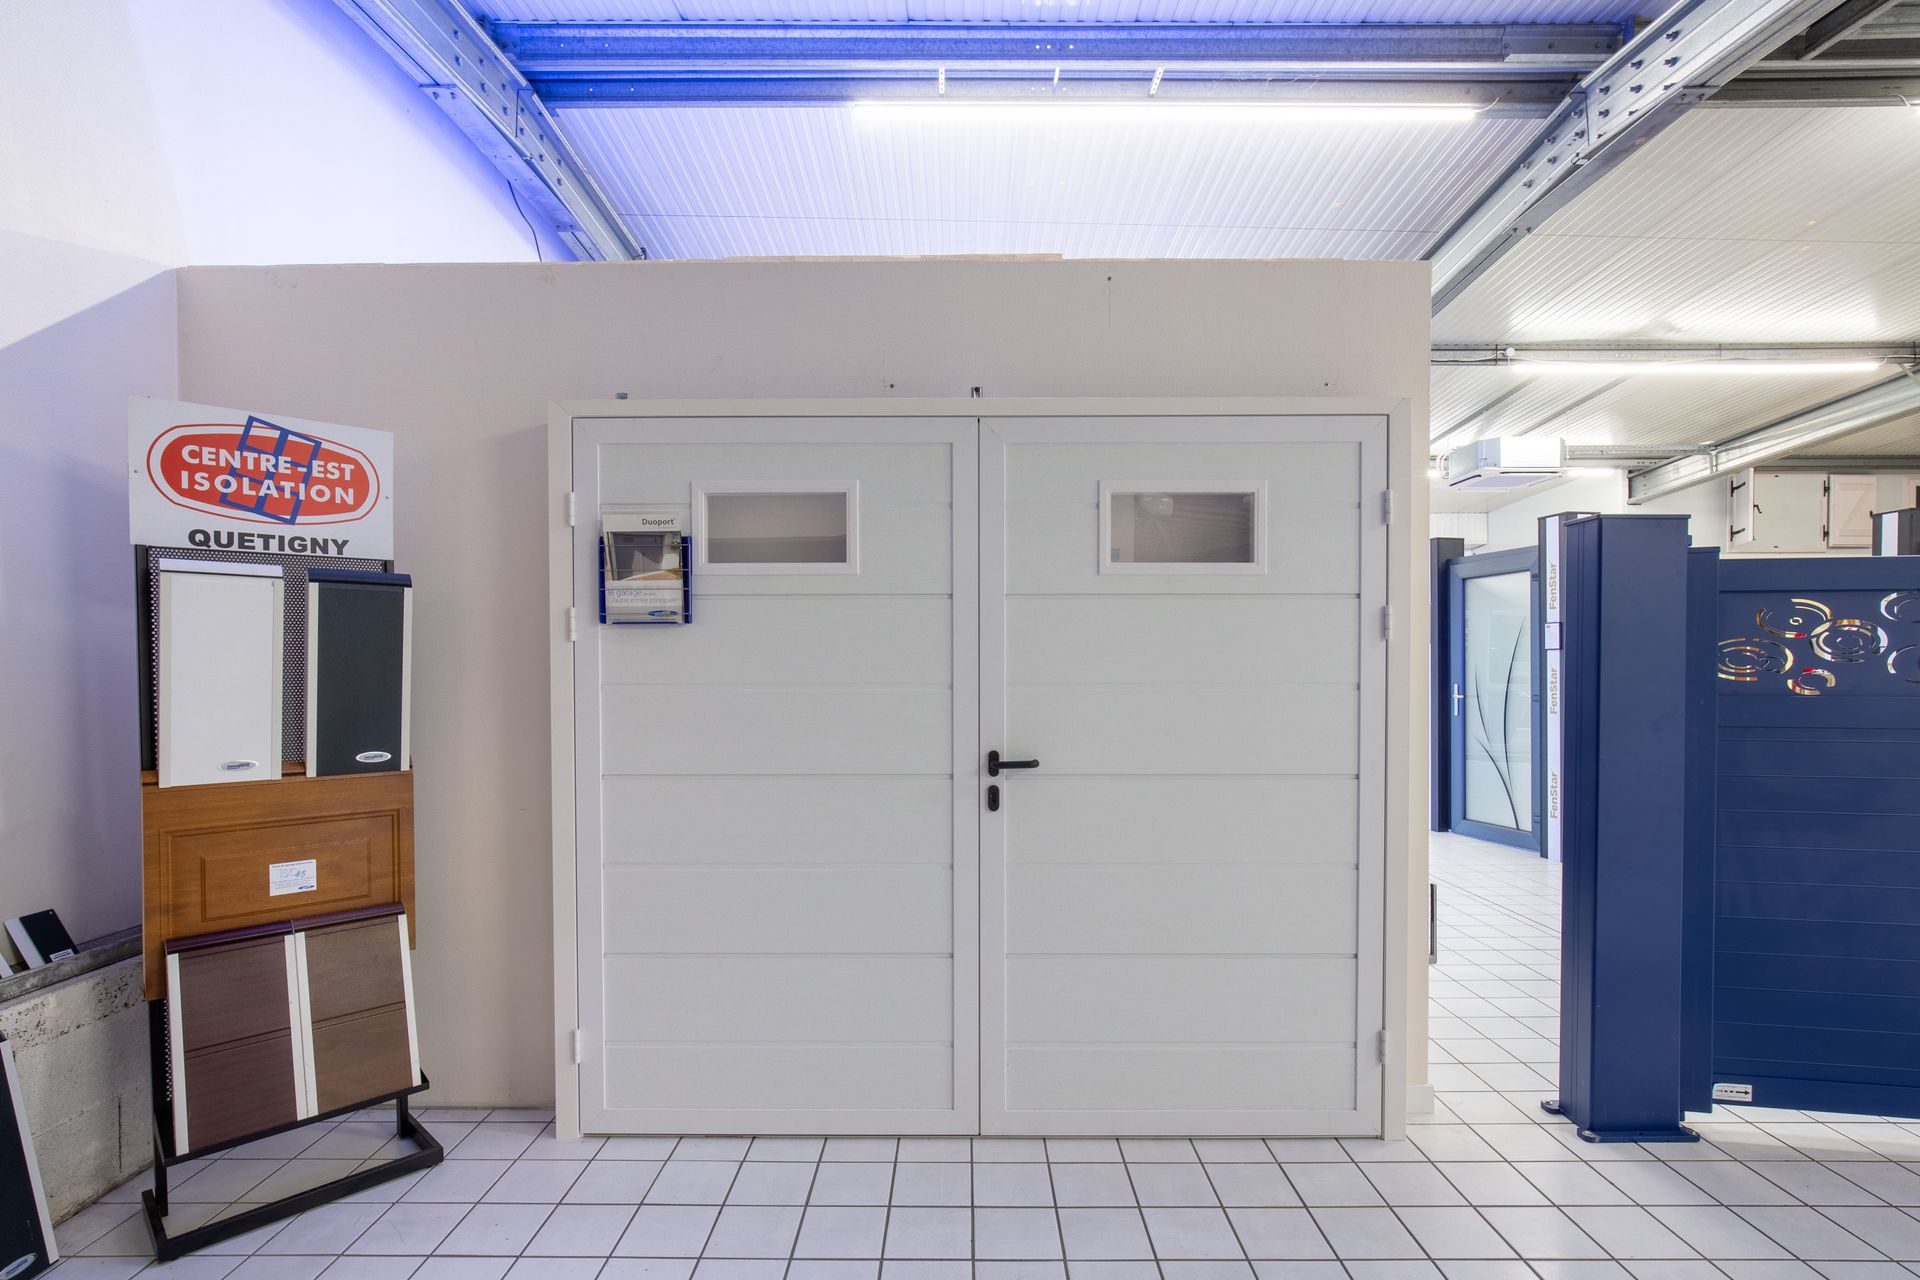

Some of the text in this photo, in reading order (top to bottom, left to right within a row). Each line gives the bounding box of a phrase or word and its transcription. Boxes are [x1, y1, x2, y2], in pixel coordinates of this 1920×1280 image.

[181, 444, 355, 482] CENTRE-EST
[181, 470, 354, 505] ISOLATION
[642, 518, 674, 527] Duoport
[188, 528, 350, 556] QUETIGNY
[1549, 563, 1557, 610] FenStar
[1550, 772, 1558, 819] FenStar
